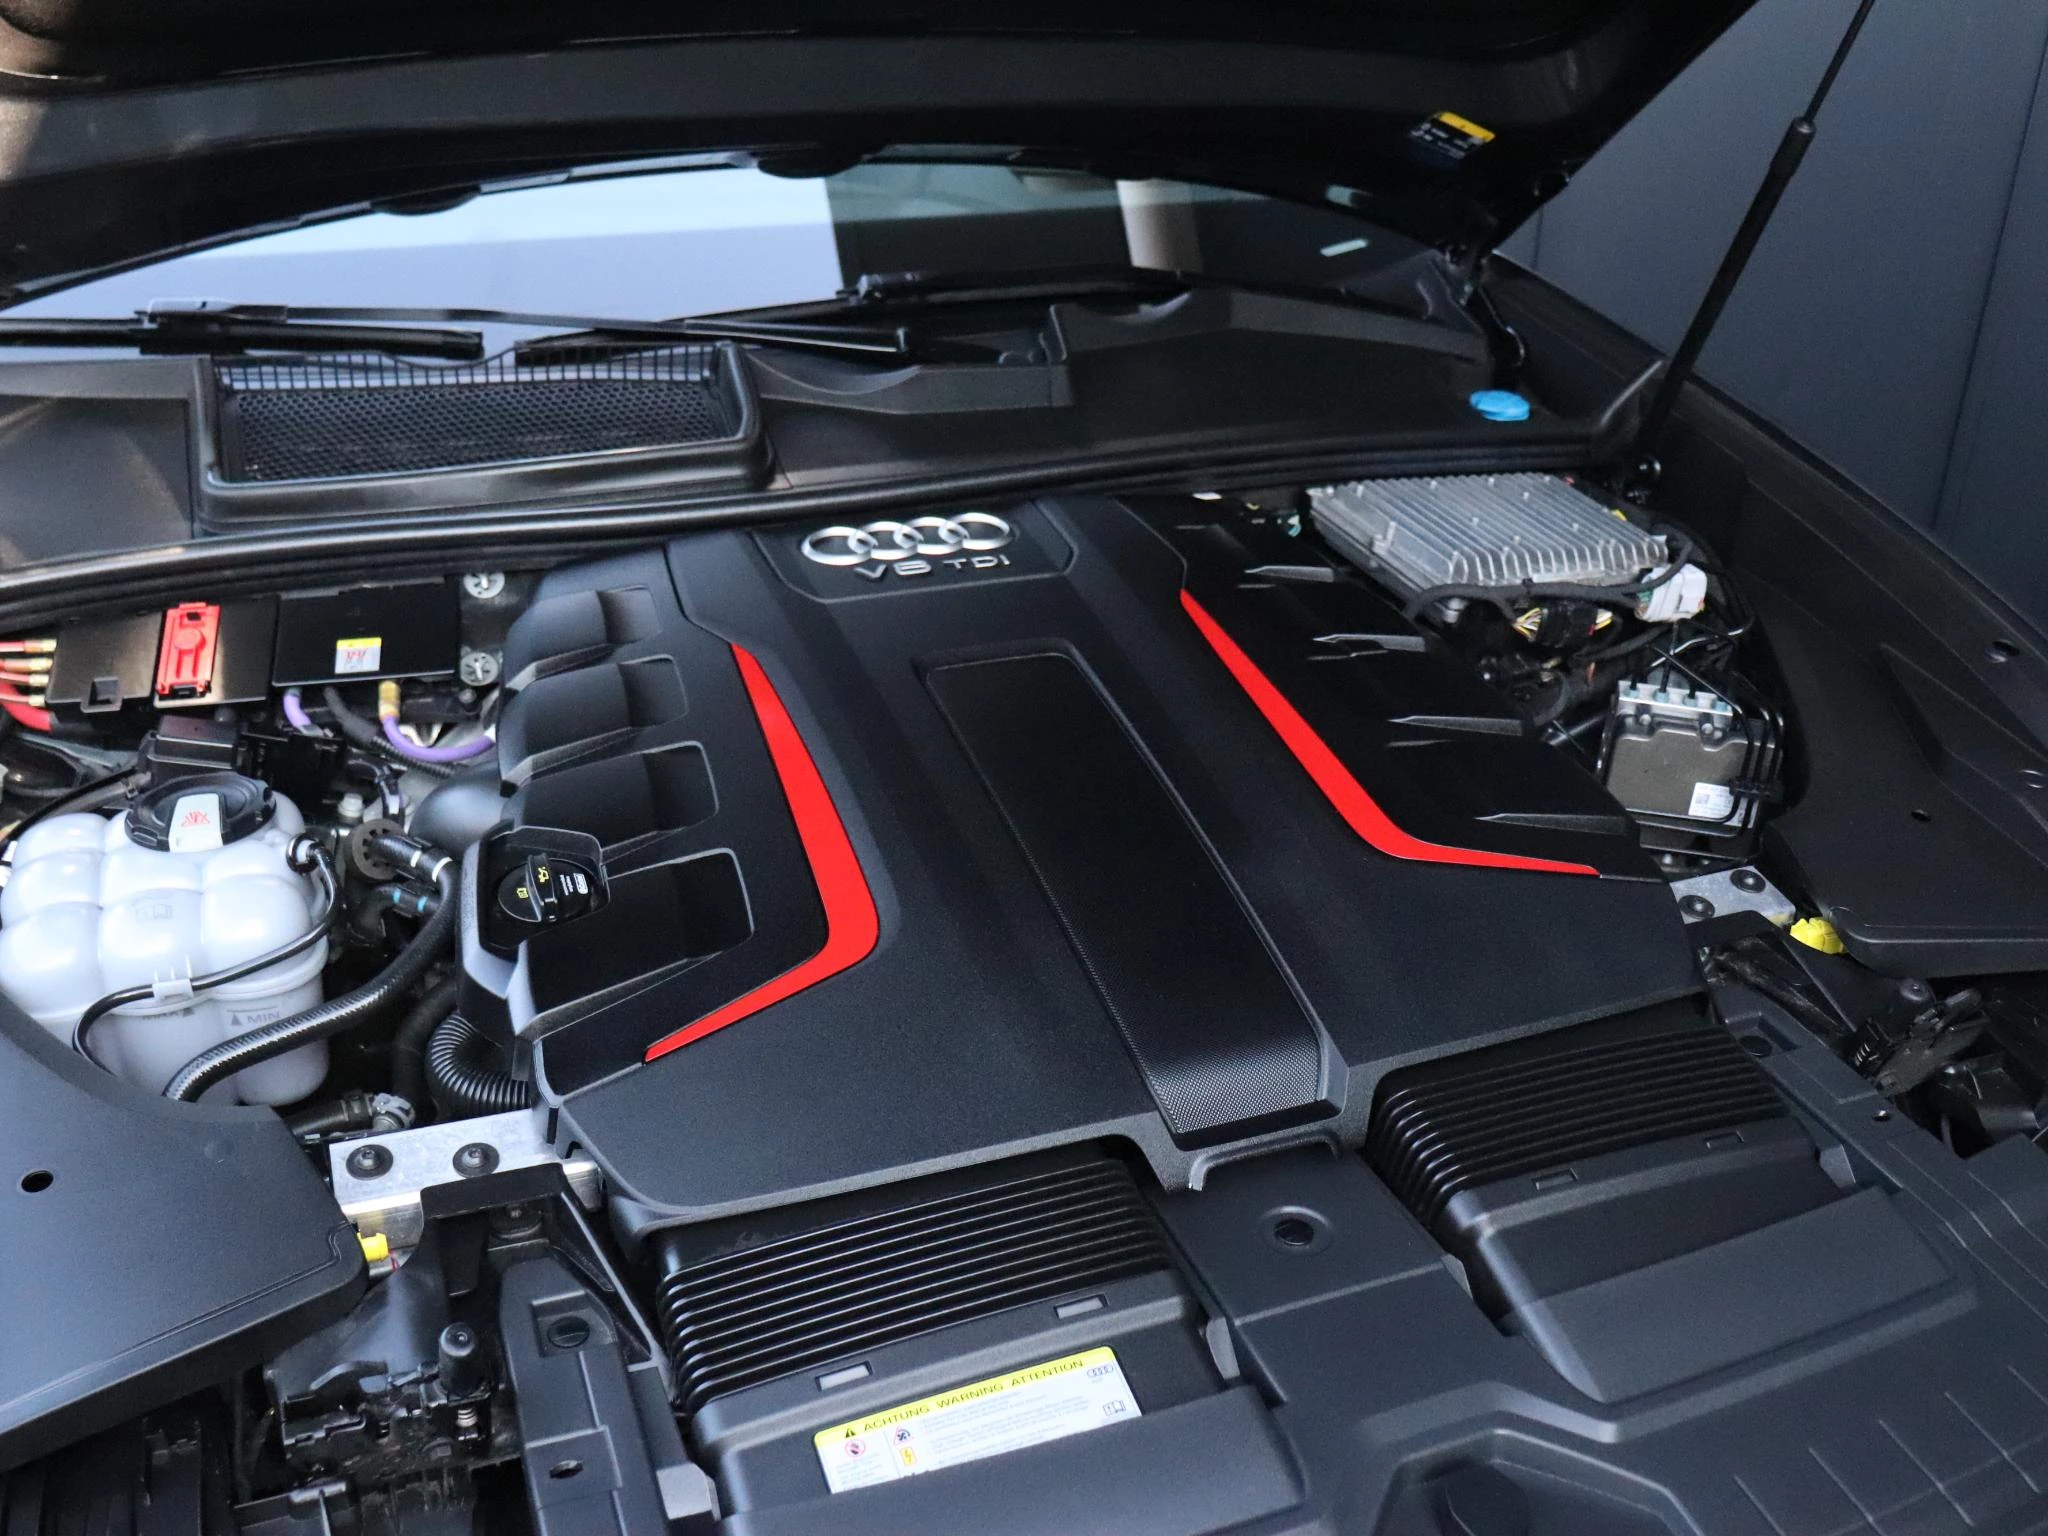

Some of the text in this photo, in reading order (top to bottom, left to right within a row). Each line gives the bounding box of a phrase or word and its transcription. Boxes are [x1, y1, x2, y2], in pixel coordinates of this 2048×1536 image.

[942, 554, 1011, 569] TDI
[247, 1010, 281, 1025] MIN
[864, 1404, 930, 1432] ACHTUNG
[936, 1382, 1004, 1408] WARNING
[1011, 1359, 1084, 1387] ATTENTION
